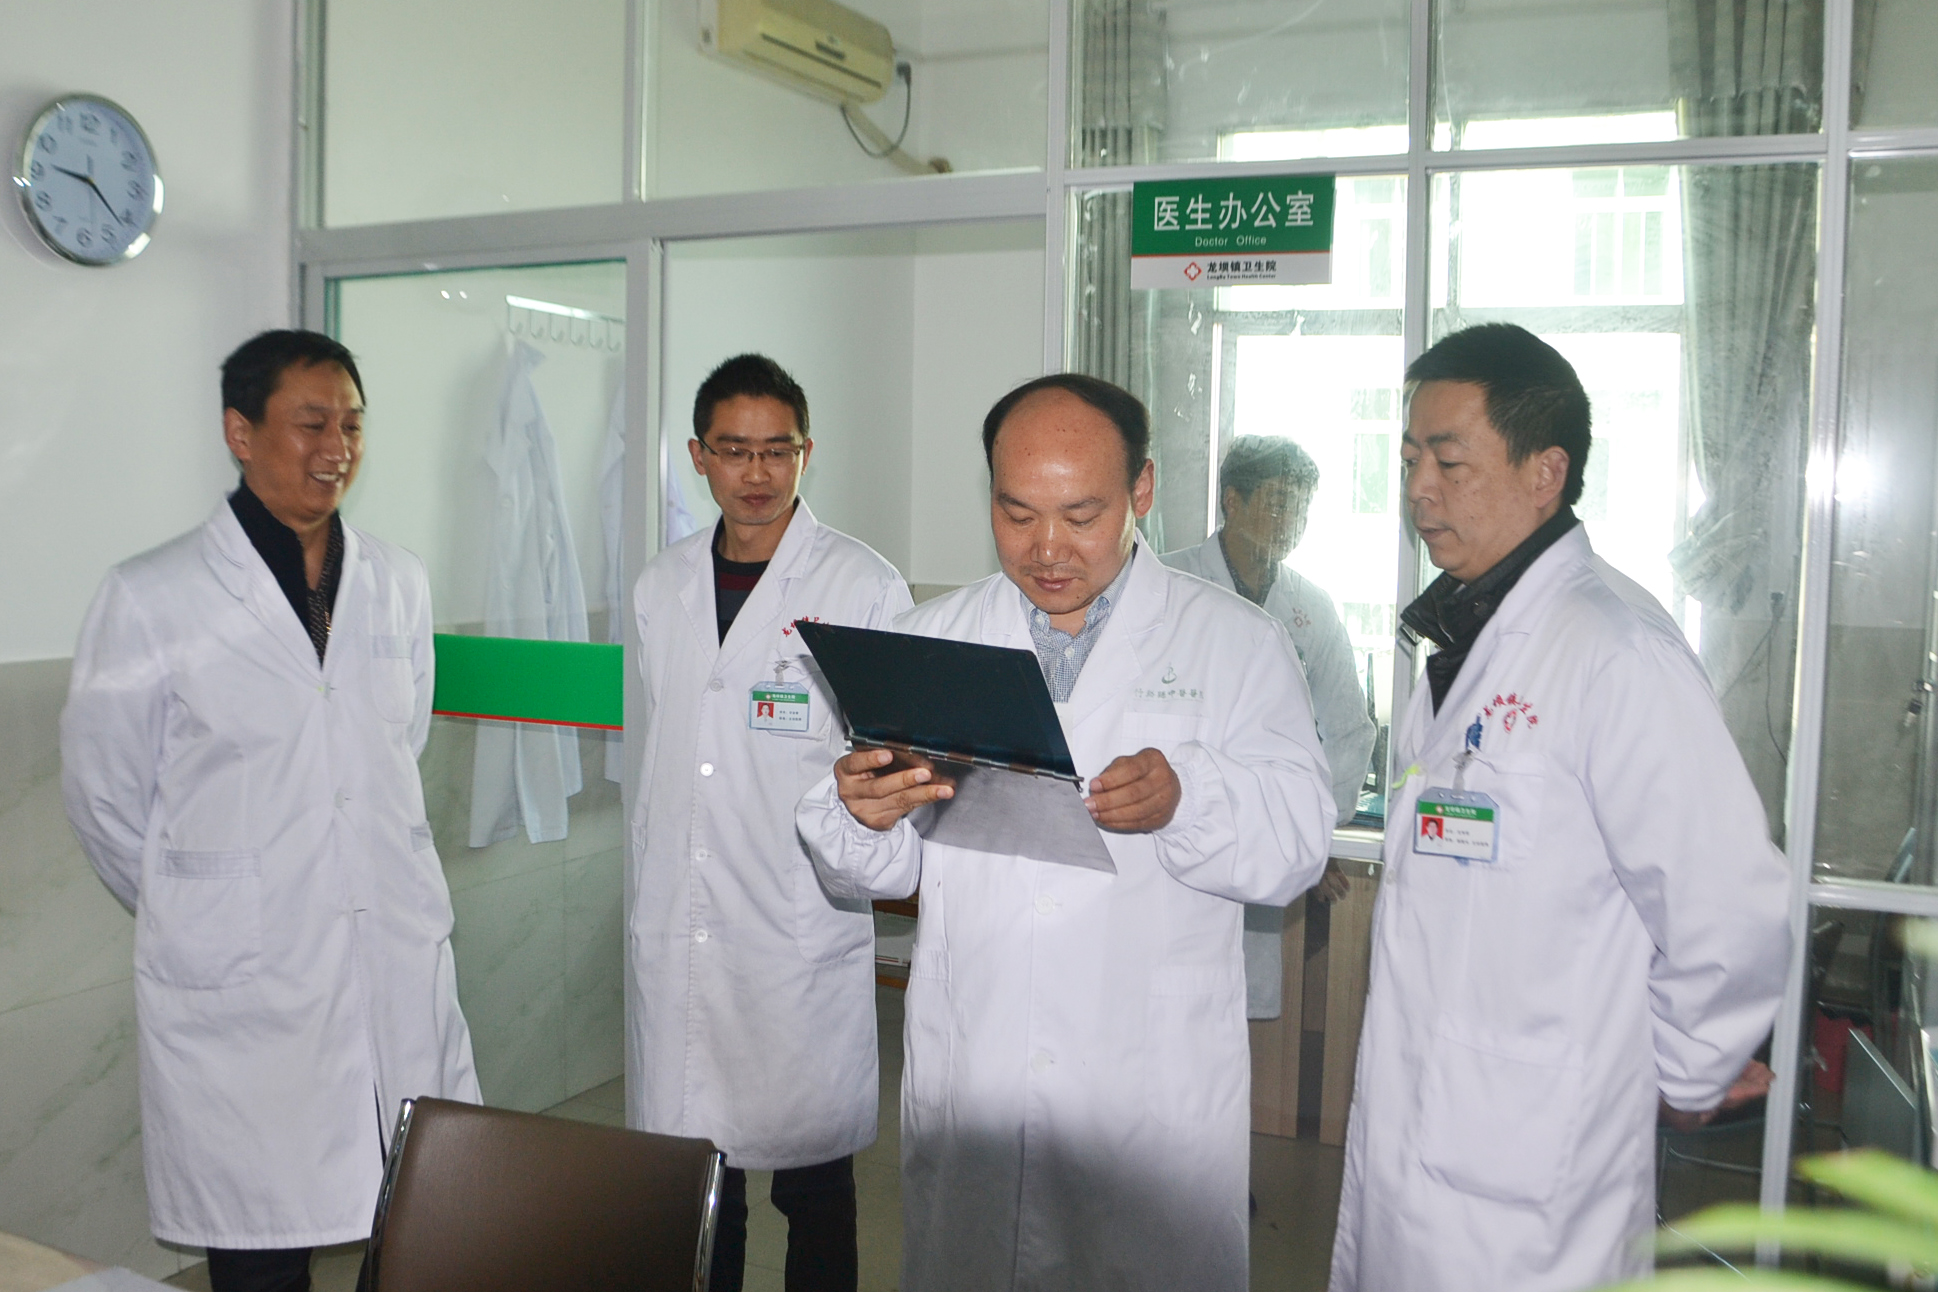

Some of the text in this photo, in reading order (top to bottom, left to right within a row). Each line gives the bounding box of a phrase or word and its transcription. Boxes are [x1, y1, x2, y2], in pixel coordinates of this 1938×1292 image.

[1153, 189, 1314, 232] 医生办公室
[1195, 234, 1267, 248] Doctor Office
[1207, 260, 1277, 274] 龙坝镇卫生院
